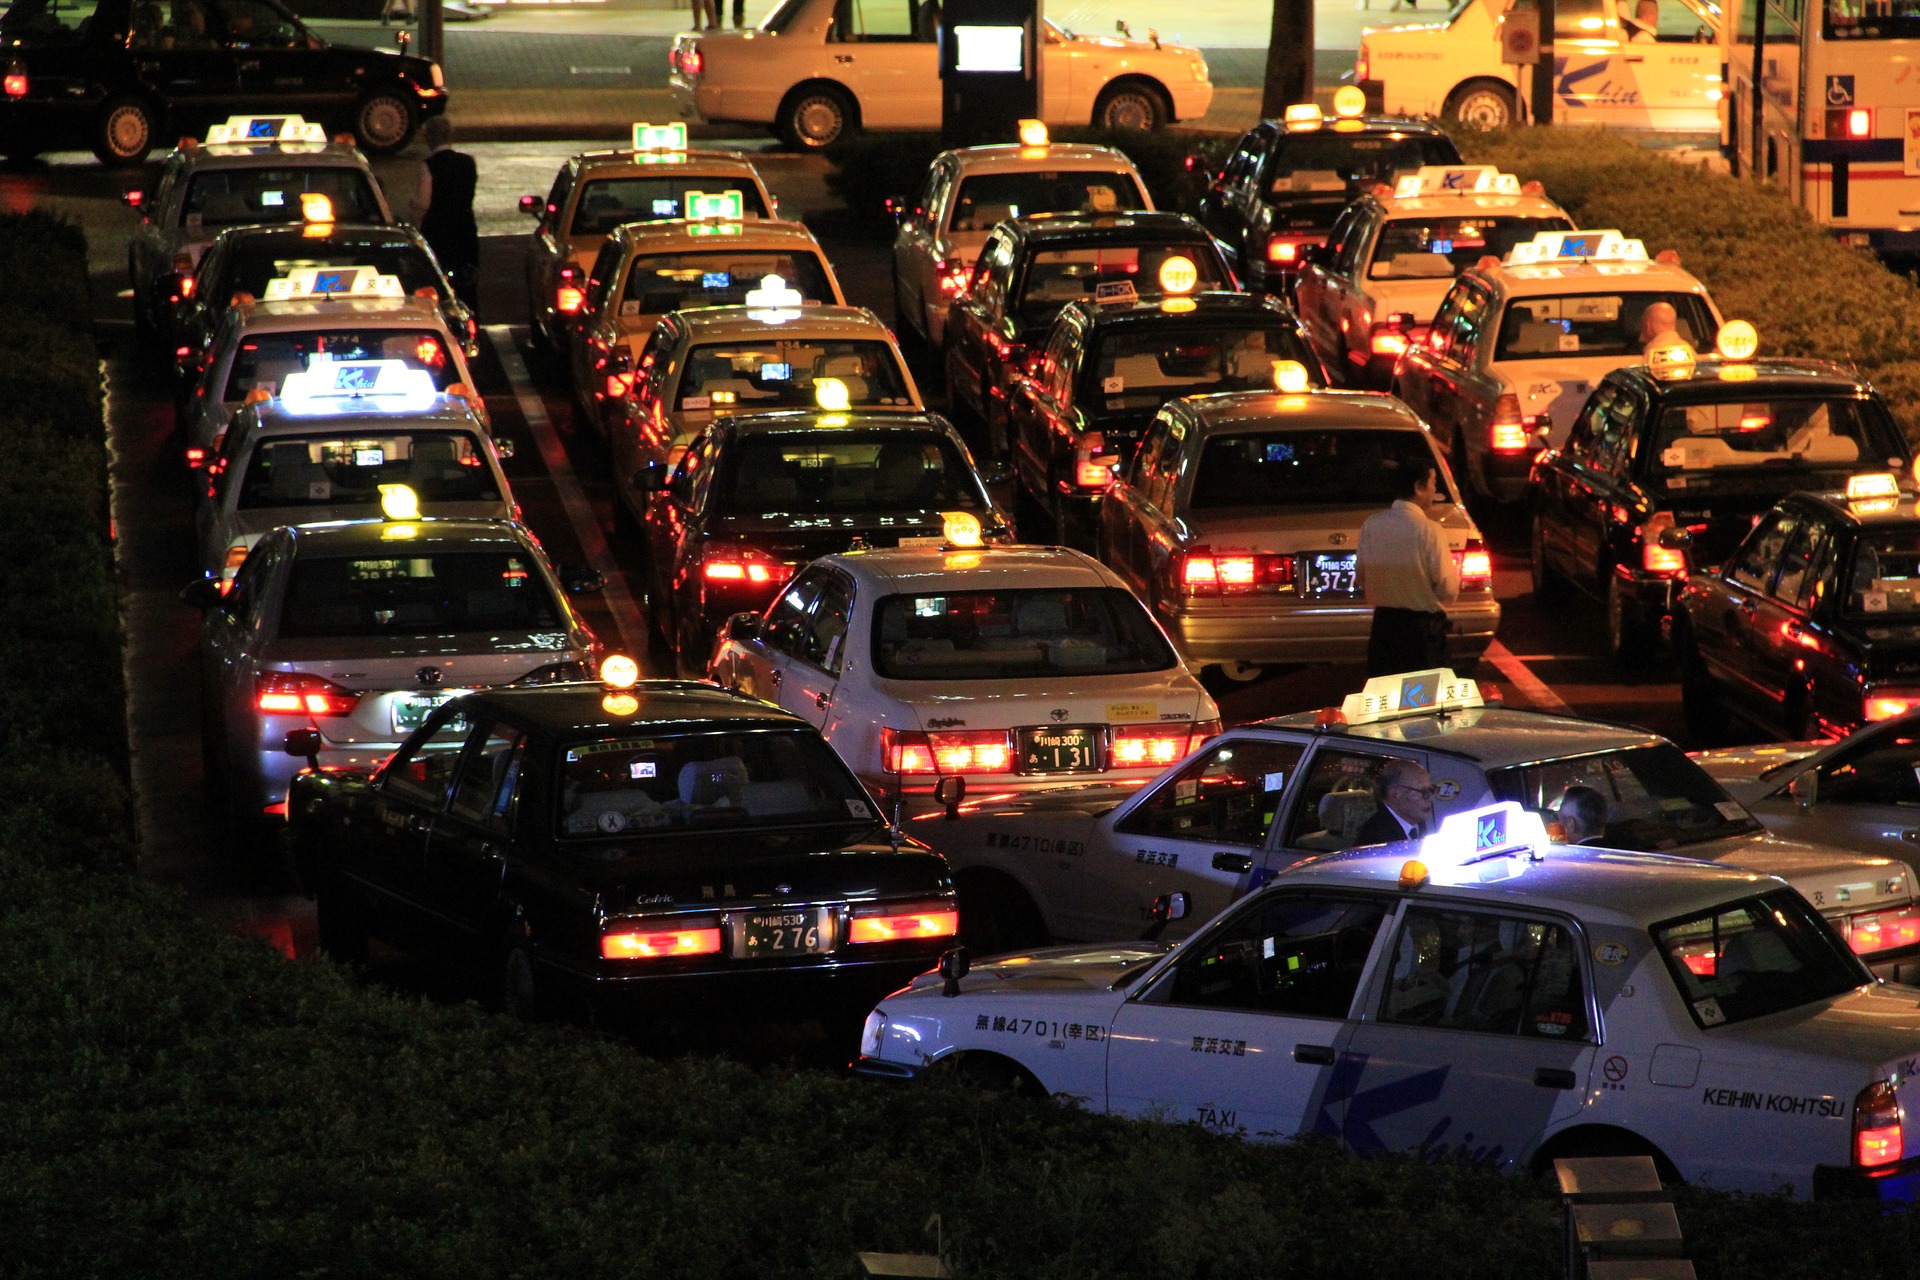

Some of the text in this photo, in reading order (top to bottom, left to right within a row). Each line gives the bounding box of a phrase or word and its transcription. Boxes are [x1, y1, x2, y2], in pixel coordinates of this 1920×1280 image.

[1040, 736, 1080, 747] 川崎 300
[1136, 849, 1179, 869] 京浜交通
[637, 894, 675, 905] Cedric
[761, 914, 802, 928] 川崎 530
[974, 1013, 1107, 1043] 無線4701(幸区)
[1190, 1035, 1247, 1058] 京浜交通
[1703, 1087, 1846, 1119] KEIHIN KOHTSU
[1197, 1107, 1237, 1128] TAXI
